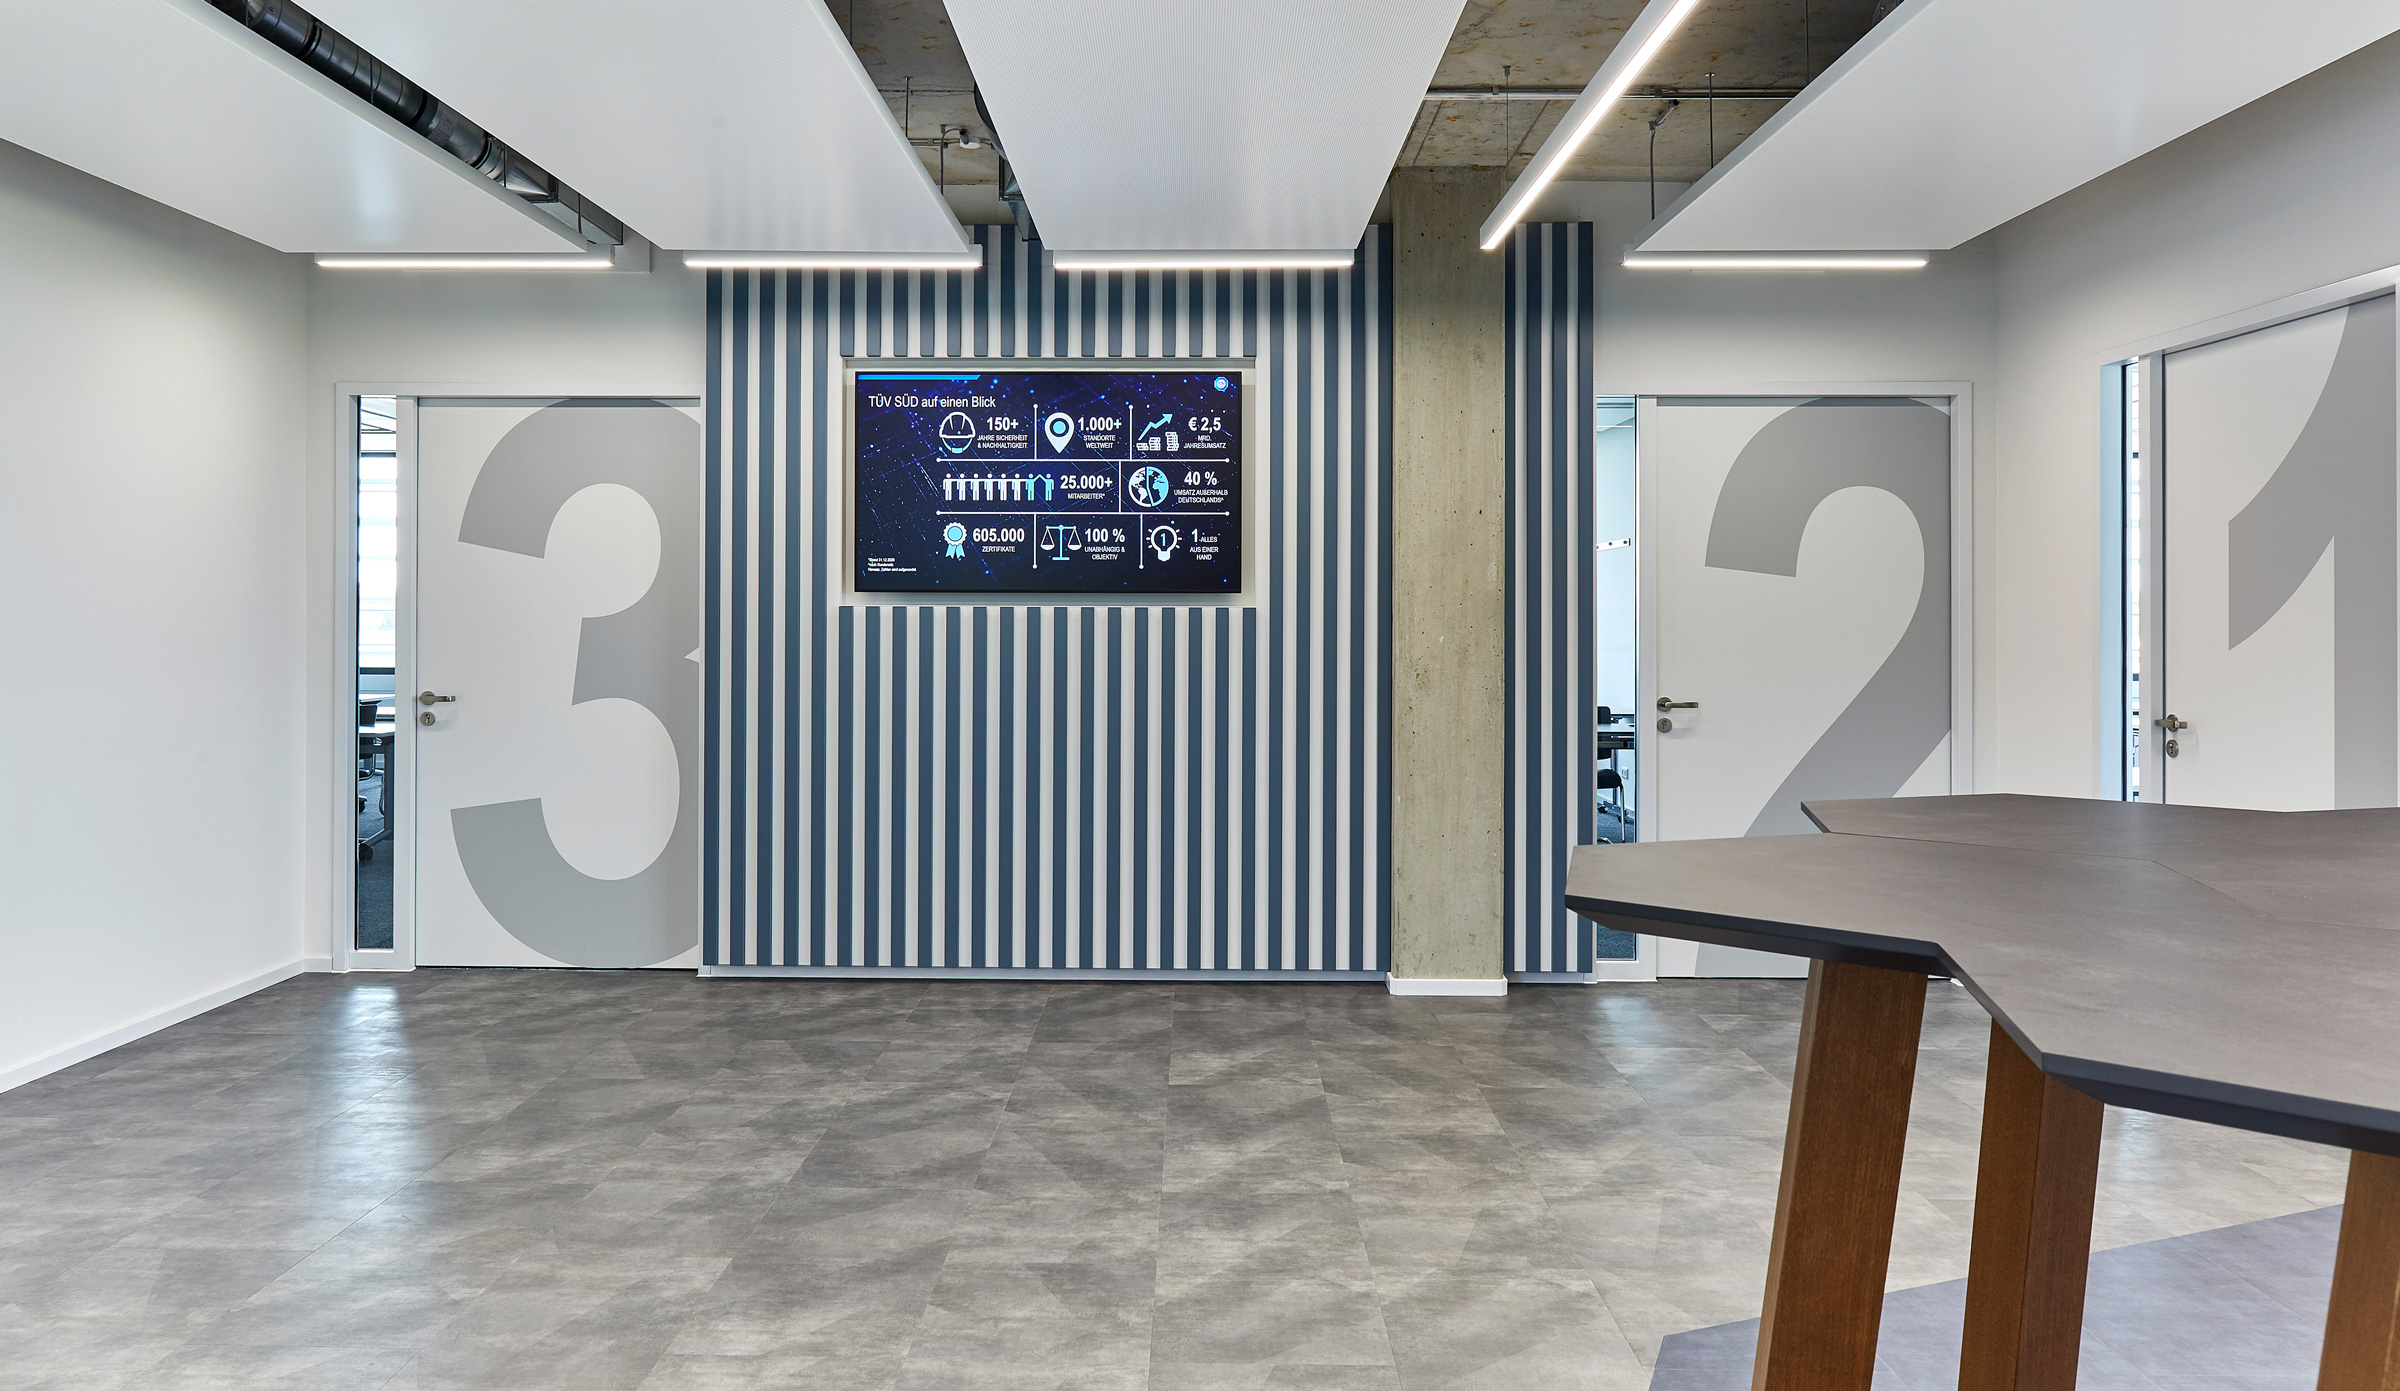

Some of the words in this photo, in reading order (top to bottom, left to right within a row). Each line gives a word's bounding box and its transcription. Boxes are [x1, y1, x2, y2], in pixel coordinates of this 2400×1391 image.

[868, 394, 891, 408] TÜV
[894, 394, 918, 408] SÜD
[922, 396, 938, 408] auf
[972, 396, 996, 408] Blick
[986, 416, 1018, 431] 150+
[1078, 416, 1122, 431] 1.000+
[1188, 417, 1198, 431] €
[1200, 417, 1222, 433] 2,5
[1060, 475, 1112, 489] 25.000+
[1184, 472, 1200, 486] 40
[1204, 472, 1218, 486] %
[972, 528, 1024, 542] 605.000
[1084, 528, 1108, 542] 100
[1112, 528, 1126, 542] %
[1160, 533, 1166, 546] 1
[1192, 528, 1198, 542] 1
[1084, 545, 1120, 553] UNABHÄNGIG
[2229, 293, 2395, 810] 1
[451, 398, 699, 968] 3
[1695, 397, 1950, 977] 2
